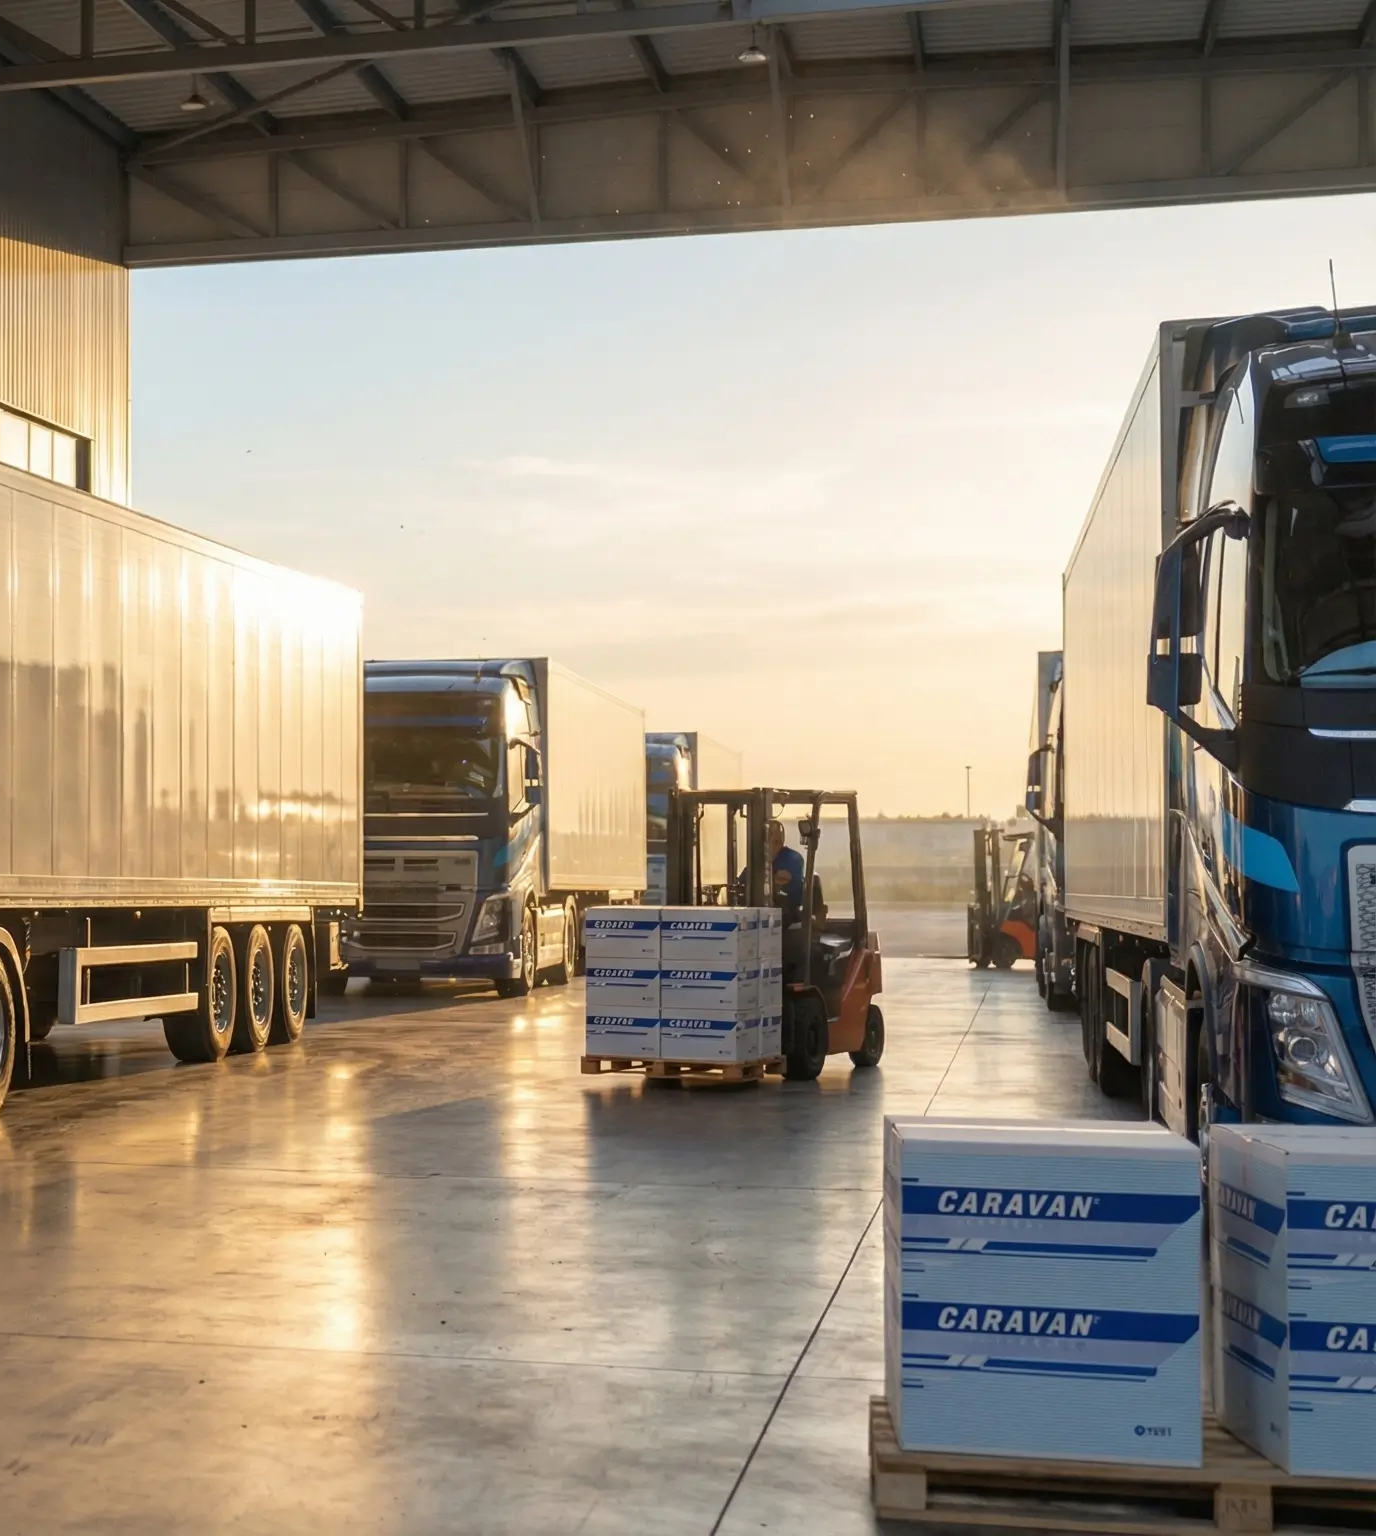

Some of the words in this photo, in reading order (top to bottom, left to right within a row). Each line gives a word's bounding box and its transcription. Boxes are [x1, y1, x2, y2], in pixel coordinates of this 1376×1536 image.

[938, 1190, 1094, 1219] CARAVAN
[1325, 1204, 1376, 1229] CA
[938, 1306, 1094, 1336] CARAVAN
[1326, 1326, 1376, 1351] CA
